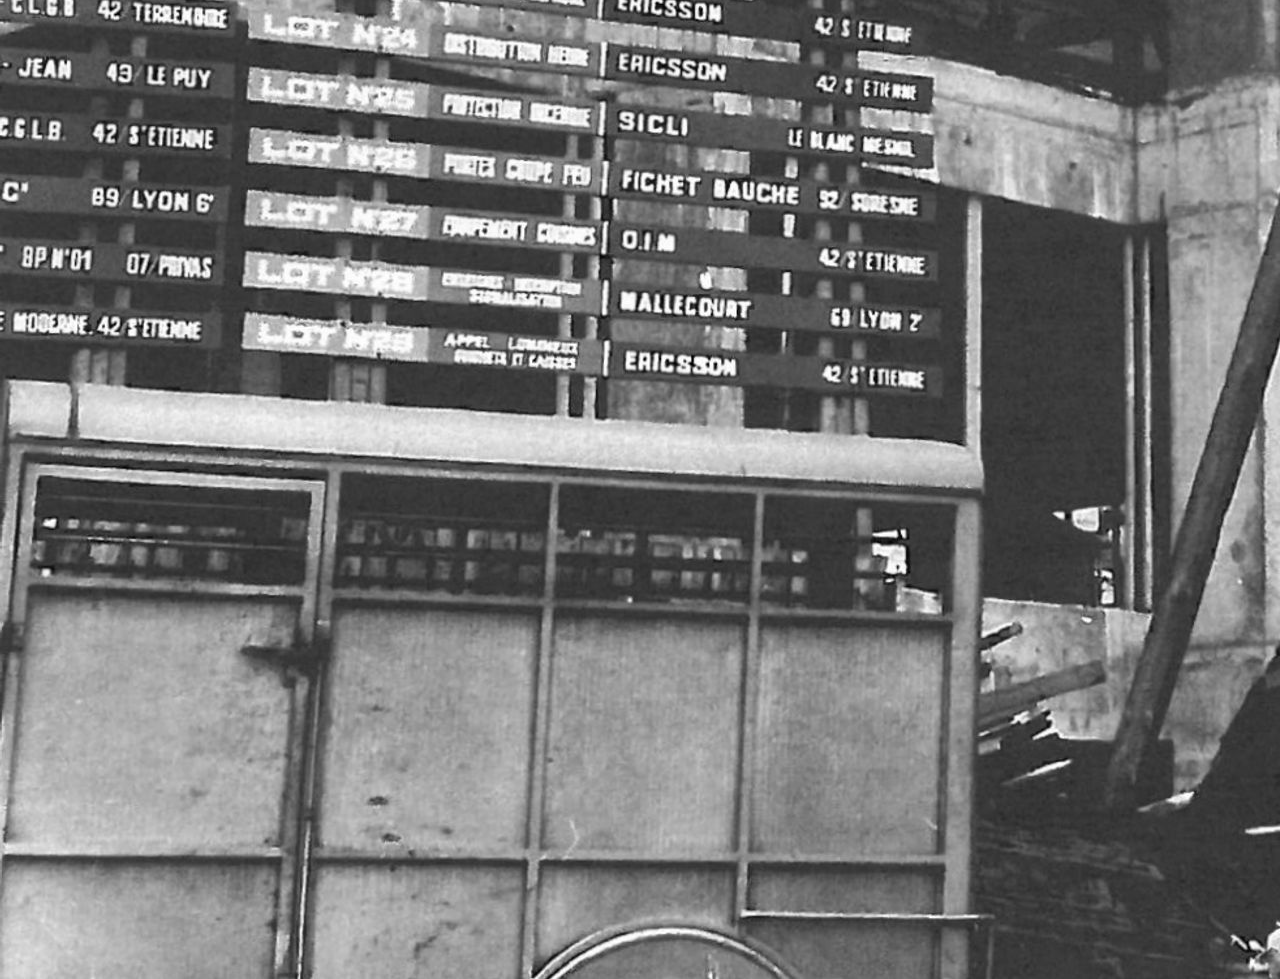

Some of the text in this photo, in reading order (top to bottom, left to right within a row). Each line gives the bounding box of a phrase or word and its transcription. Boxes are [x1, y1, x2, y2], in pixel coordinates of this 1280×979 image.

[263, 13, 340, 40] LOT
[18, 57, 72, 79] JEAN
[147, 65, 166, 86] LE
[173, 67, 211, 88] PUY
[618, 52, 727, 81] ERICSSON
[261, 75, 341, 102] LOT
[619, 111, 688, 136] SICLI
[262, 137, 341, 163] LOT
[810, 130, 855, 152] BLANC
[132, 189, 190, 212] LYON
[622, 169, 800, 205] FICHET BAUCHE
[260, 198, 338, 225] LOT
[257, 259, 337, 286] LOT
[620, 290, 751, 319] MALLECOURT
[257, 321, 338, 347] LOT
[625, 349, 737, 377] ERICSSON
